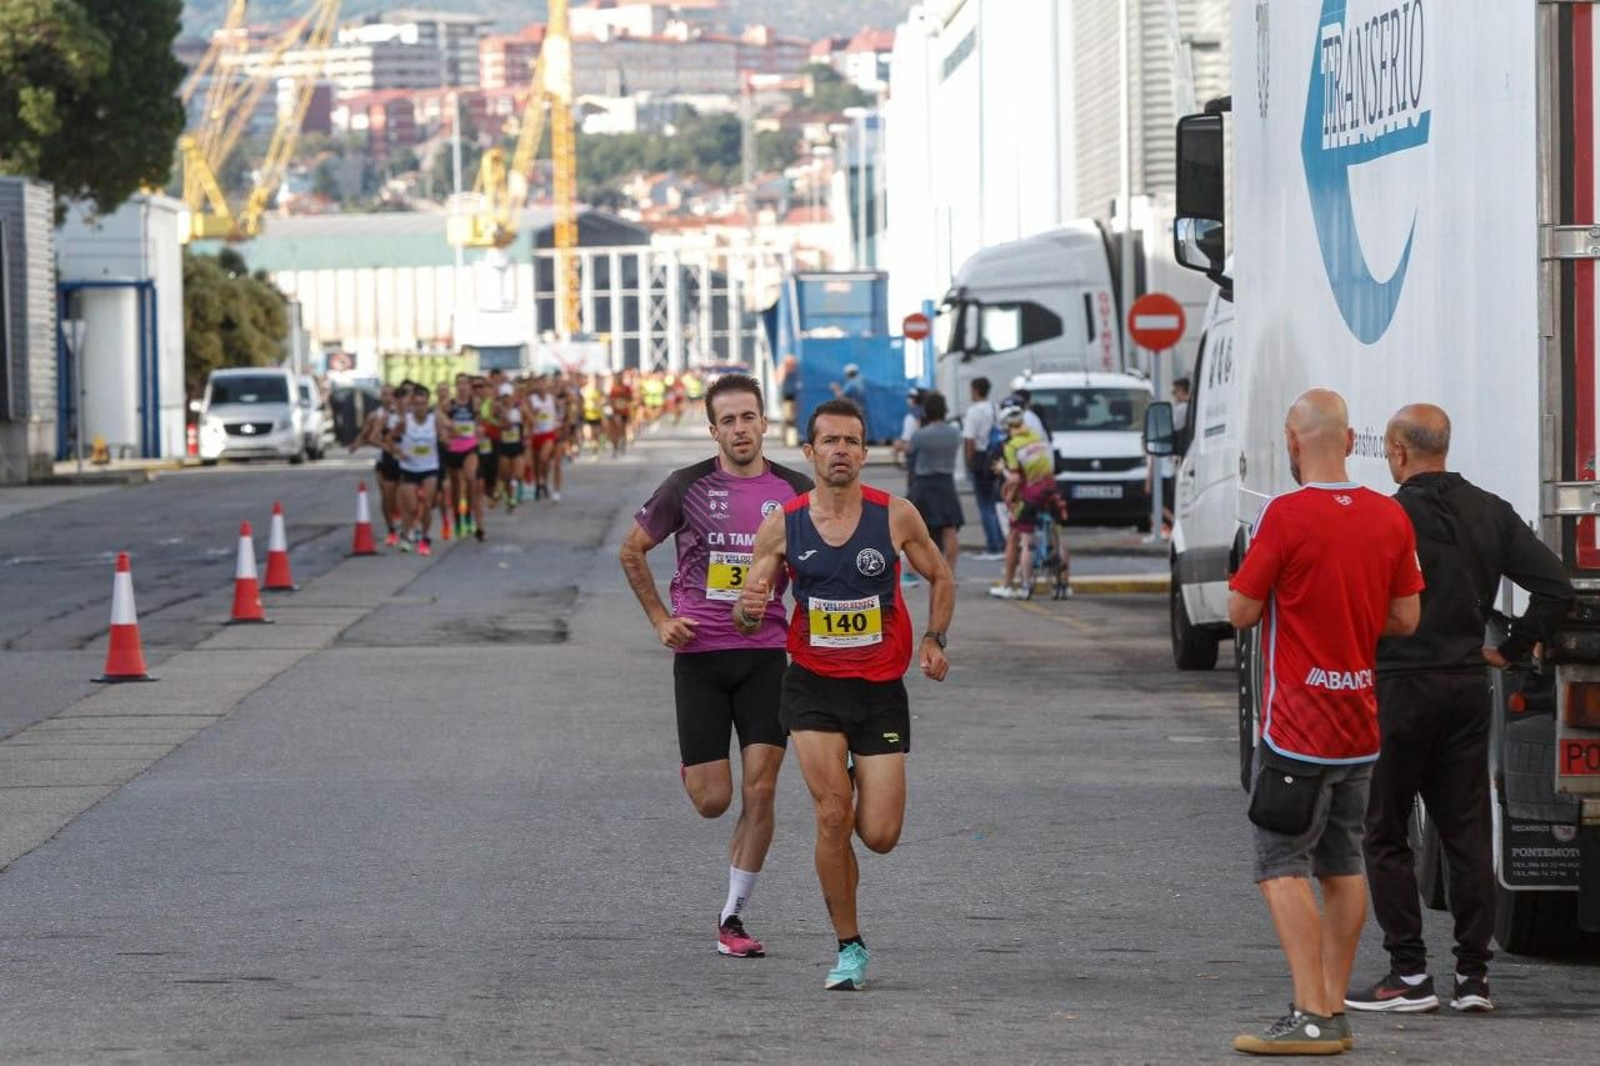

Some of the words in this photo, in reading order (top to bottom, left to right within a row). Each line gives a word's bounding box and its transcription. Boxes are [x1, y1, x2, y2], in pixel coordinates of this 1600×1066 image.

[1322, 0, 1424, 135] TRANSFRIO
[708, 532, 725, 545] CA
[730, 567, 749, 586] 3
[823, 613, 867, 632] 140
